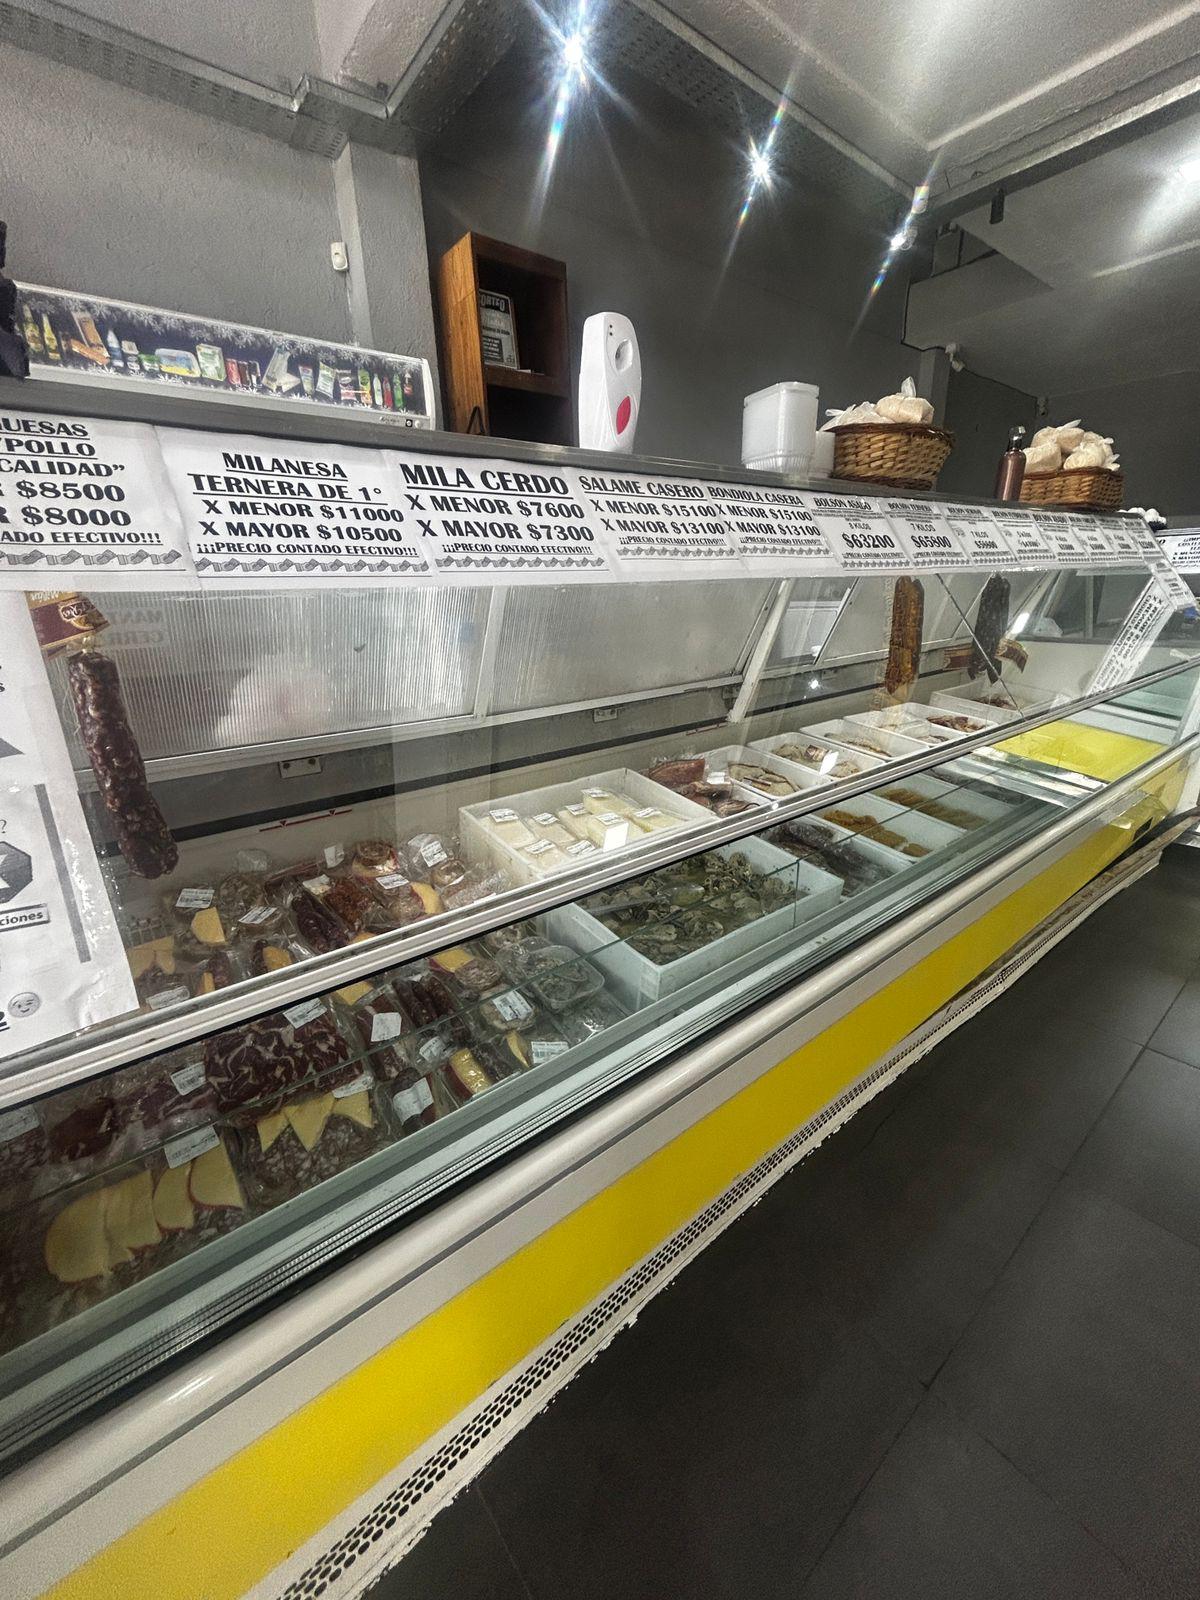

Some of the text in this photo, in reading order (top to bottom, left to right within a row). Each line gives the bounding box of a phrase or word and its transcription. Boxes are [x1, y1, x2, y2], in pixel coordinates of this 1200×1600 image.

[0, 418, 89, 437] UESAS
[222, 452, 347, 478] MILANESA
[187, 473, 313, 497] TERNERA
[318, 483, 353, 500] DE
[399, 463, 569, 495] MILA CERDO
[578, 475, 705, 498] SALAME CASERO
[16, 480, 125, 502] $8500
[707, 486, 805, 505] BONDIOLA CASERA
[202, 500, 404, 522] X MENOR $11000
[403, 494, 585, 519] X MENOR $7600
[589, 499, 717, 517] X MENOR $15100
[812, 497, 848, 508] BOLSON
[21, 505, 131, 526] $8000
[714, 503, 726, 515] X
[726, 505, 769, 519] MENOR
[769, 508, 813, 522] $15100
[198, 521, 402, 541] X MAYOR $10500
[416, 519, 594, 541] X MAYOR $7300
[600, 518, 725, 535] X MAYOR $13100
[724, 520, 821, 536] X MAYOR $13100
[51, 532, 162, 543] EFECTIVO!!!
[655, 537, 688, 545] CONTADO
[842, 532, 895, 549] $63200
[910, 535, 952, 549] $65800
[197, 542, 418, 556] ¡¡¡PRECIO CONTADO EFECTIVO!!!
[495, 544, 540, 553] CONTADO
[541, 545, 593, 554] EFECTIVO!!!
